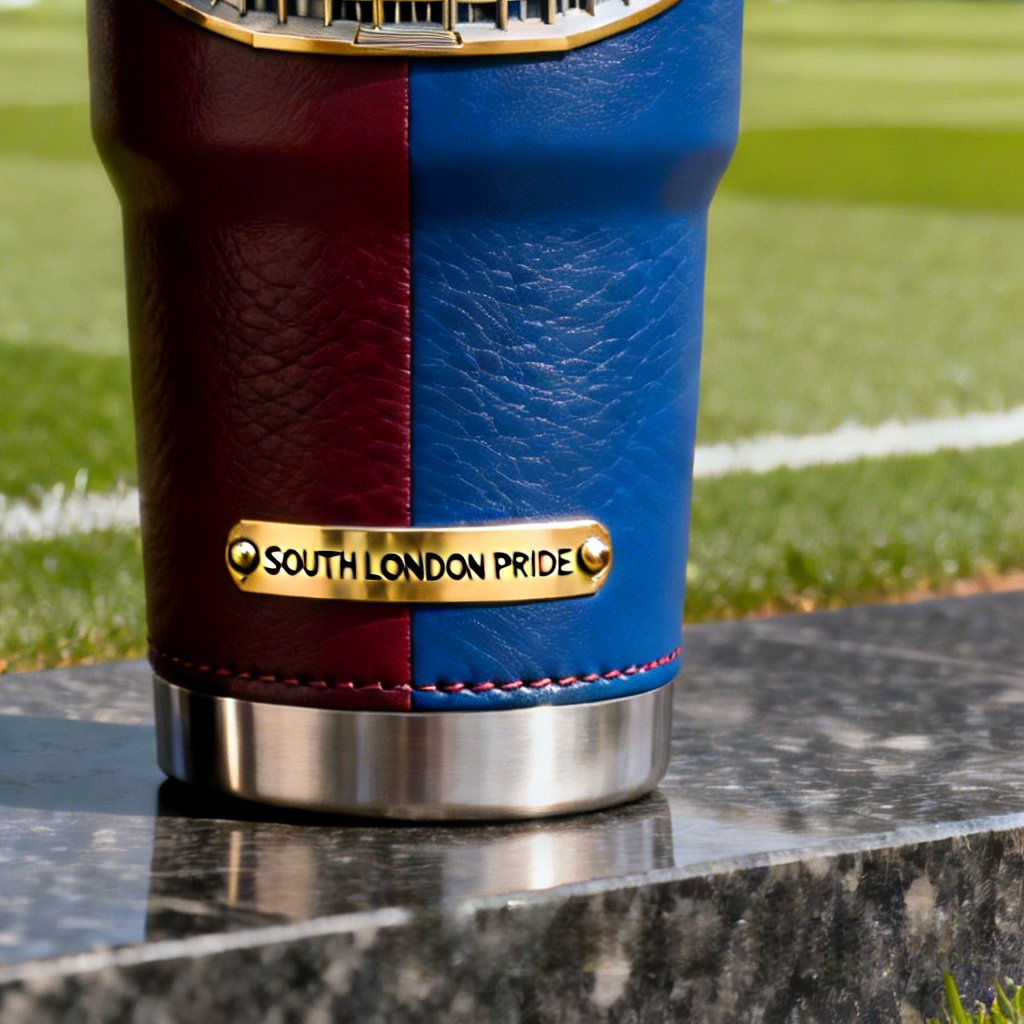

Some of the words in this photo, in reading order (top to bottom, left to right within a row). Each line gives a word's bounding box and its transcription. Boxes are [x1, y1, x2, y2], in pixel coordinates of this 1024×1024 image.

[264, 546, 357, 580] SOUTH
[365, 551, 485, 581] LONDON
[494, 548, 574, 578] PRIDE
